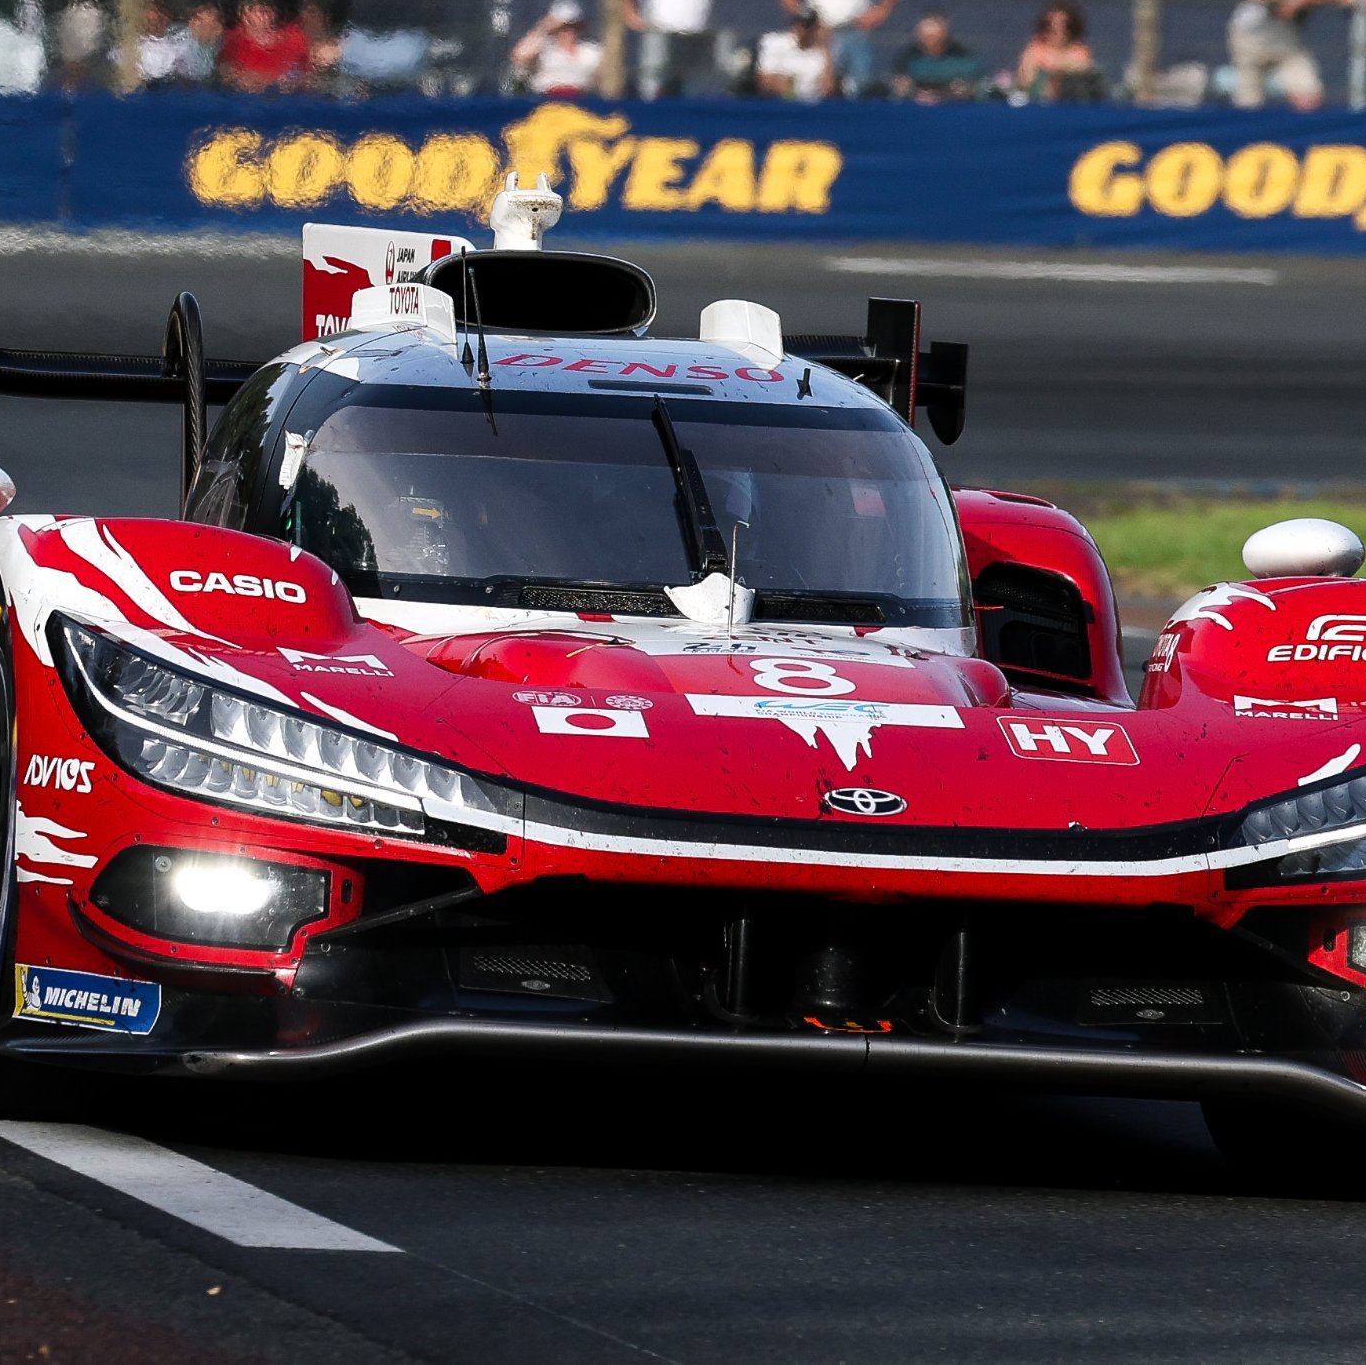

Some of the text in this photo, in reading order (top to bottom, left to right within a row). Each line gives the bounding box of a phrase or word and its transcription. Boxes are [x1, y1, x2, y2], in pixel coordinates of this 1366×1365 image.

[186, 102, 843, 223] GOODYEAR
[396, 247, 416, 264] JAPAN
[389, 286, 419, 315] TOYOTA
[492, 353, 785, 383] DENSO
[168, 569, 308, 605] CASIO
[293, 663, 396, 678] MARELLI
[749, 657, 858, 696] 8
[515, 692, 577, 705] FIA
[1235, 710, 1339, 721] MARELLI
[1009, 723, 1115, 756] HY
[23, 754, 96, 794] ADVICS
[43, 986, 142, 1018] MICHELIN
